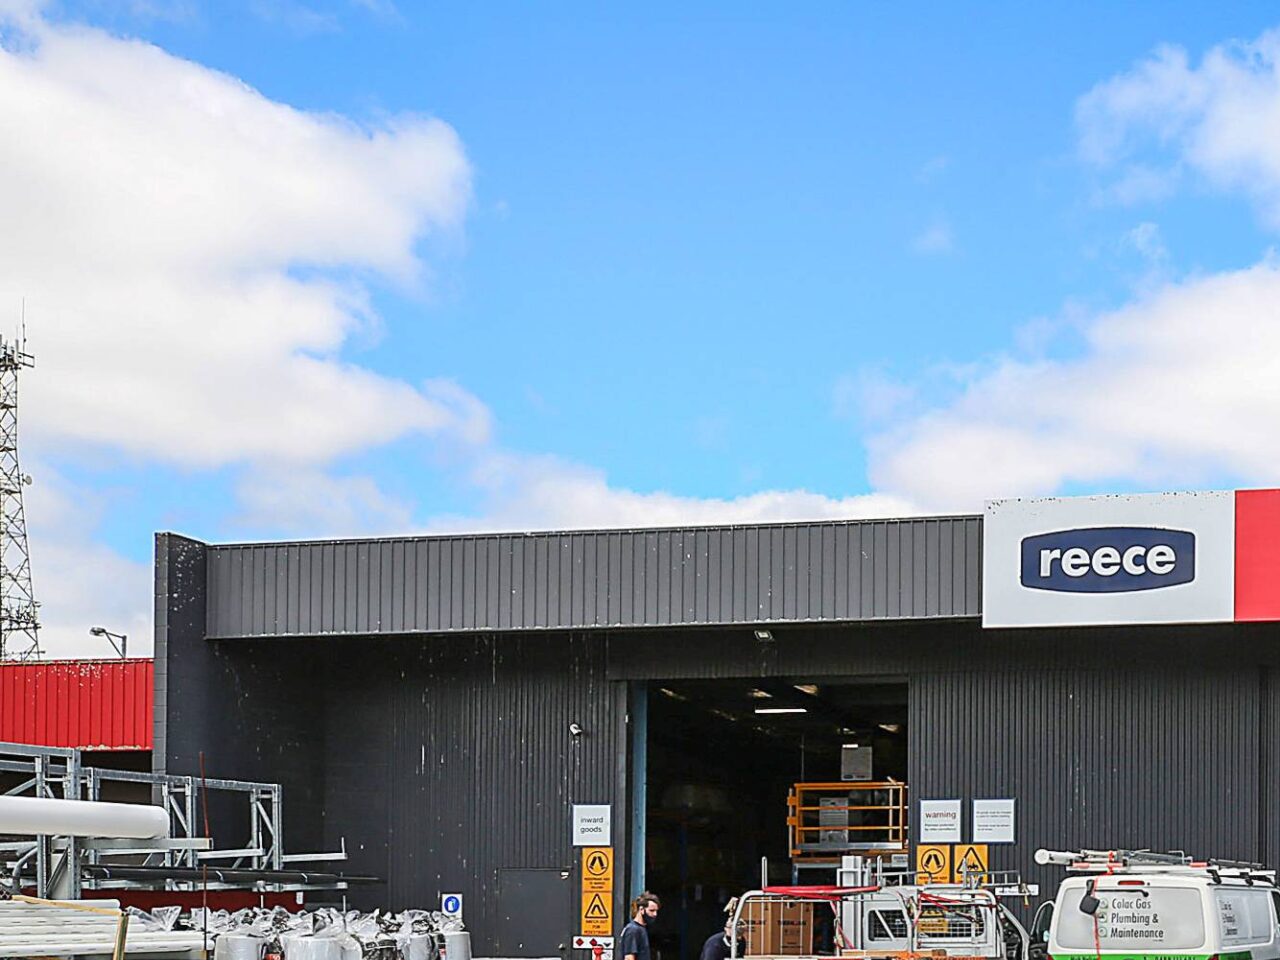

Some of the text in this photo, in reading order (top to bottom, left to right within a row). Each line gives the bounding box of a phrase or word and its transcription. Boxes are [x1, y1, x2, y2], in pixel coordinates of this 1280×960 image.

[1039, 544, 1176, 577] reece
[580, 816, 603, 824] inward
[925, 811, 957, 820] warning
[580, 826, 602, 834] goods
[1112, 898, 1152, 909] Colac Gas
[1111, 912, 1159, 926] Plumbing &
[1110, 927, 1164, 938] Maintenance
